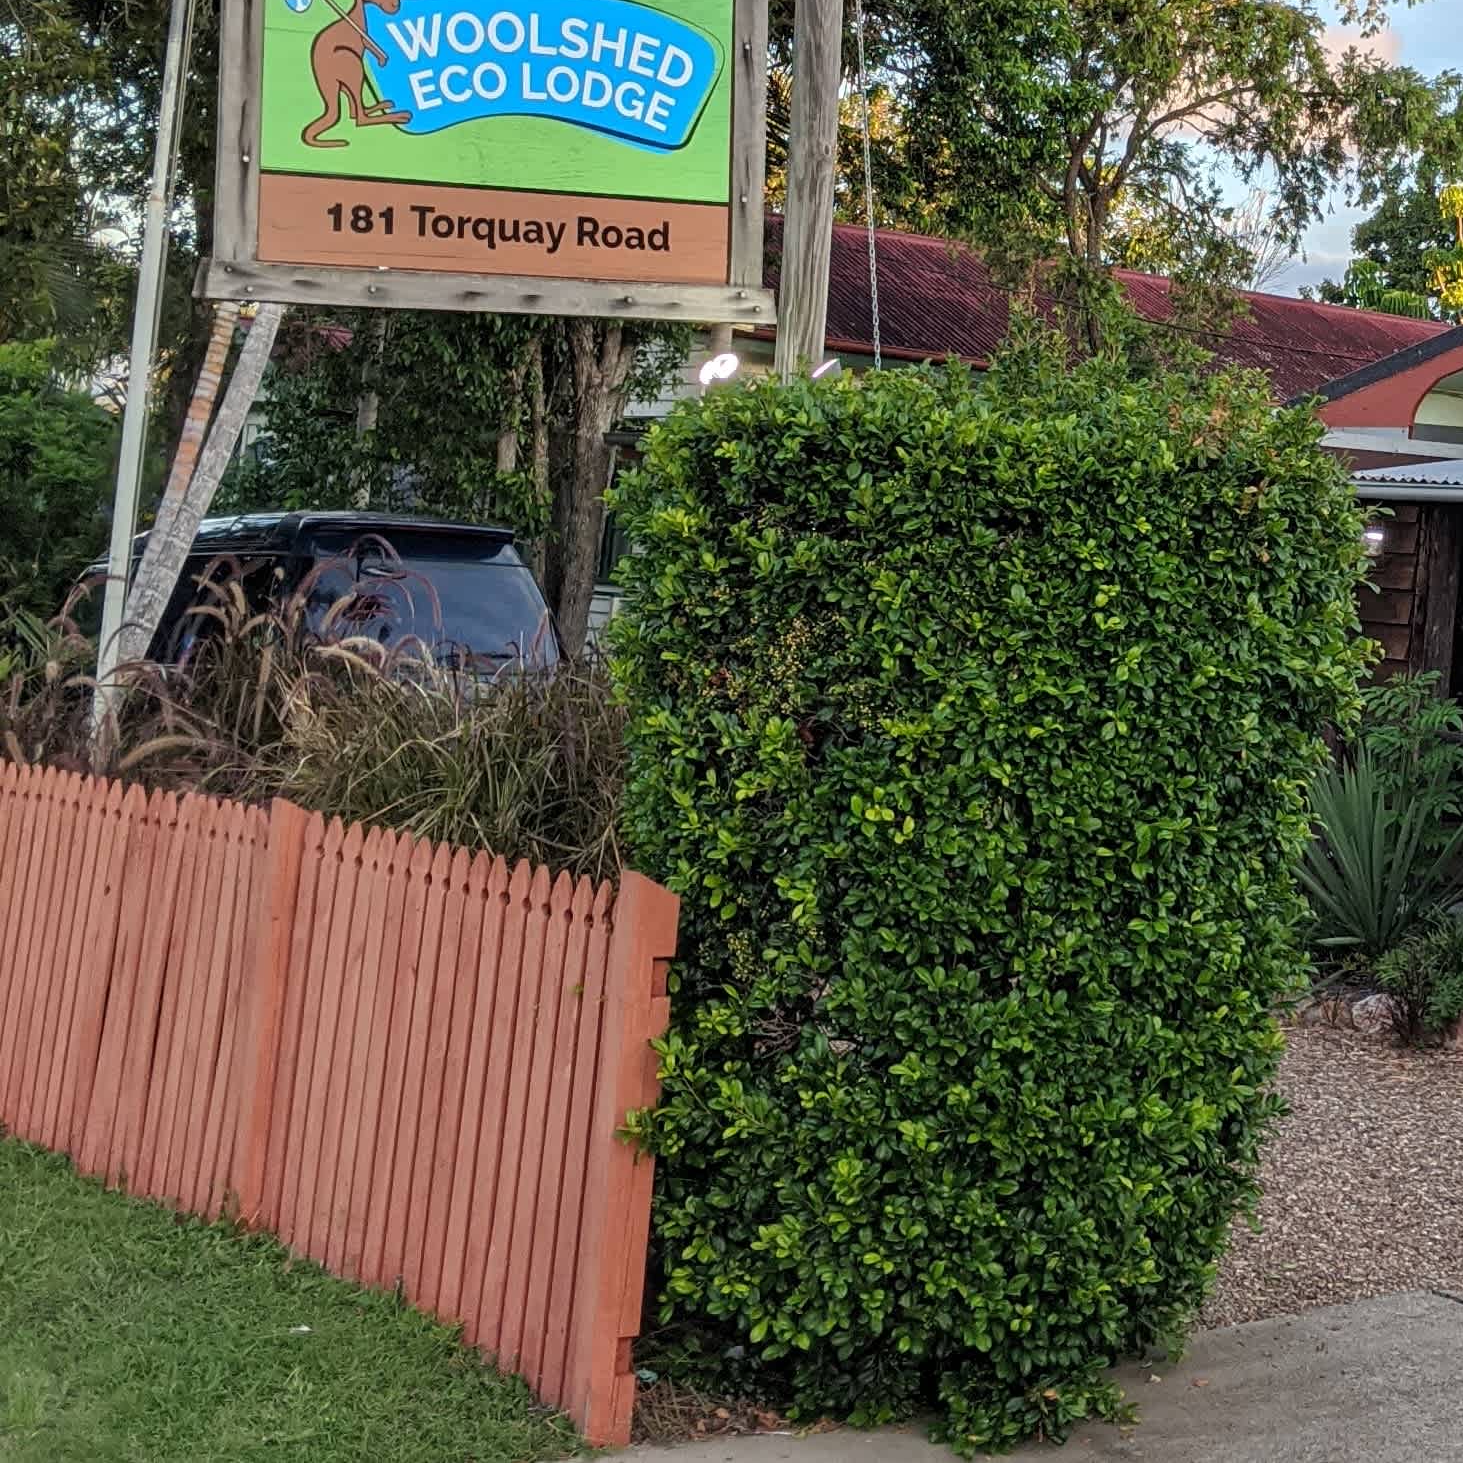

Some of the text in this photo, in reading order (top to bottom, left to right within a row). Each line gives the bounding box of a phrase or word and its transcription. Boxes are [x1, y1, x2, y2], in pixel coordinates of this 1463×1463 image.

[386, 11, 694, 88] WOOLSHED
[408, 61, 676, 133] ECO LODGE
[326, 202, 671, 254] 181 Torquay Road
